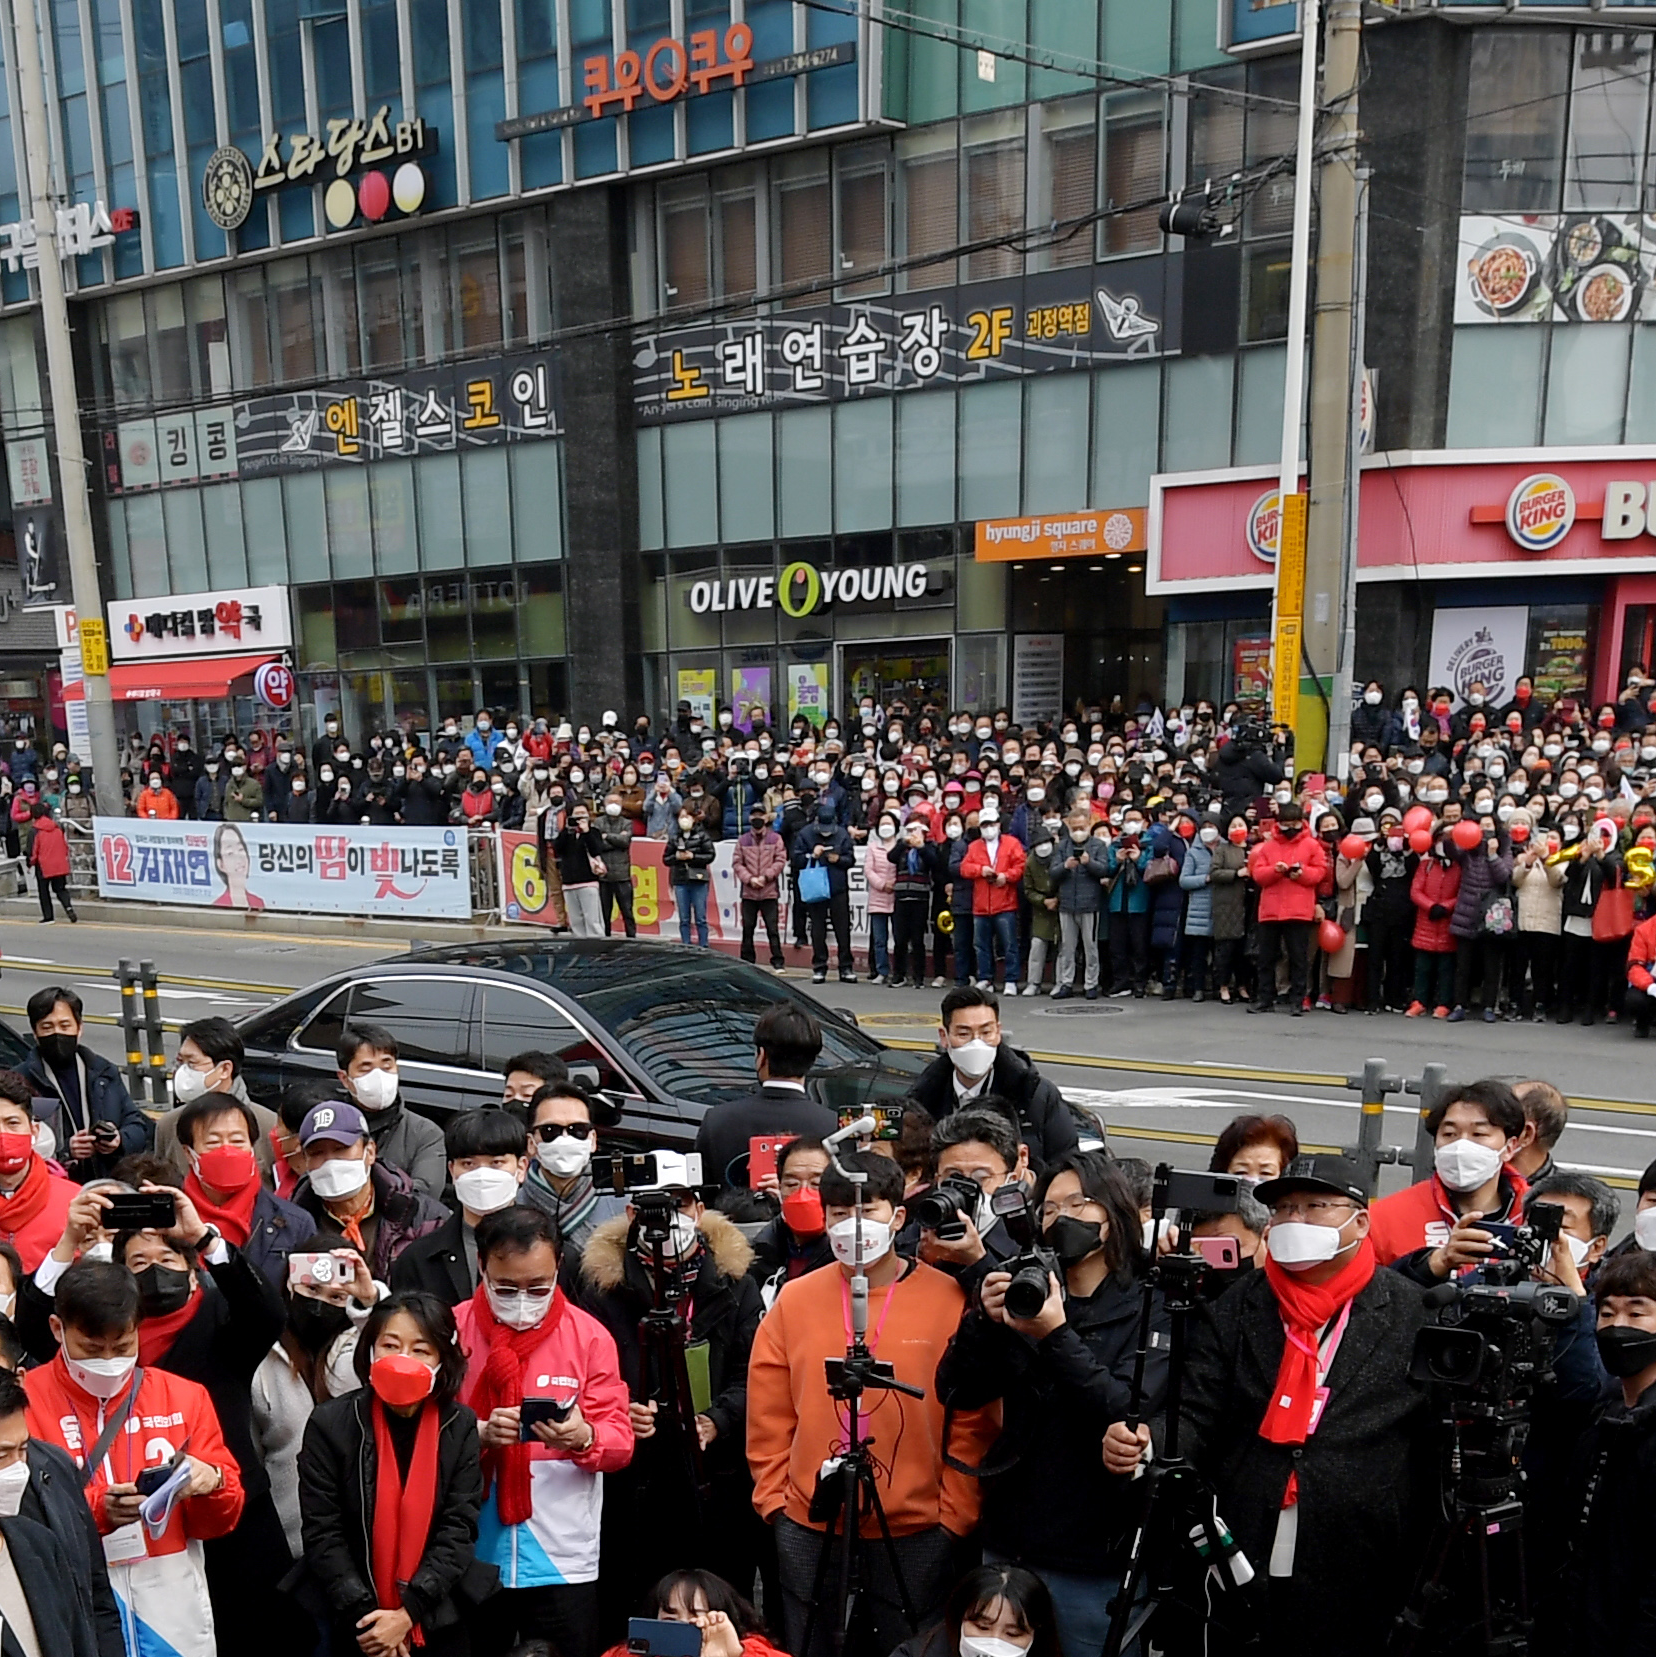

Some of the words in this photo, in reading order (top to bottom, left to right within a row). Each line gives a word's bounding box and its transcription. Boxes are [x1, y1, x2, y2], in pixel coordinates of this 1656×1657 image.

[396, 117, 425, 154] B1
[667, 305, 949, 402] 노래연습장
[966, 307, 1013, 361] 2F
[1025, 302, 1091, 340] 괴정역점
[324, 363, 549, 455] 엔젤스코인
[167, 421, 229, 468] 킹콩
[1517, 488, 1567, 518] BURGER
[1518, 504, 1567, 531] KING
[986, 522, 1041, 543] hyungji
[1043, 516, 1098, 540] square
[689, 574, 775, 615] OLIVE
[818, 563, 928, 603] YOUNG
[1445, 635, 1477, 673] DELIVERY
[1458, 653, 1504, 677] BURGER
[267, 668, 289, 702] 약
[1461, 669, 1505, 698] KING
[100, 833, 136, 886] 12
[138, 845, 213, 887] 김재연
[258, 842, 314, 876] 당신의
[314, 835, 366, 882] 땀이
[369, 841, 461, 901] 빛나도록
[510, 842, 548, 914] 6
[142, 1411, 185, 1429] 국민의힘
